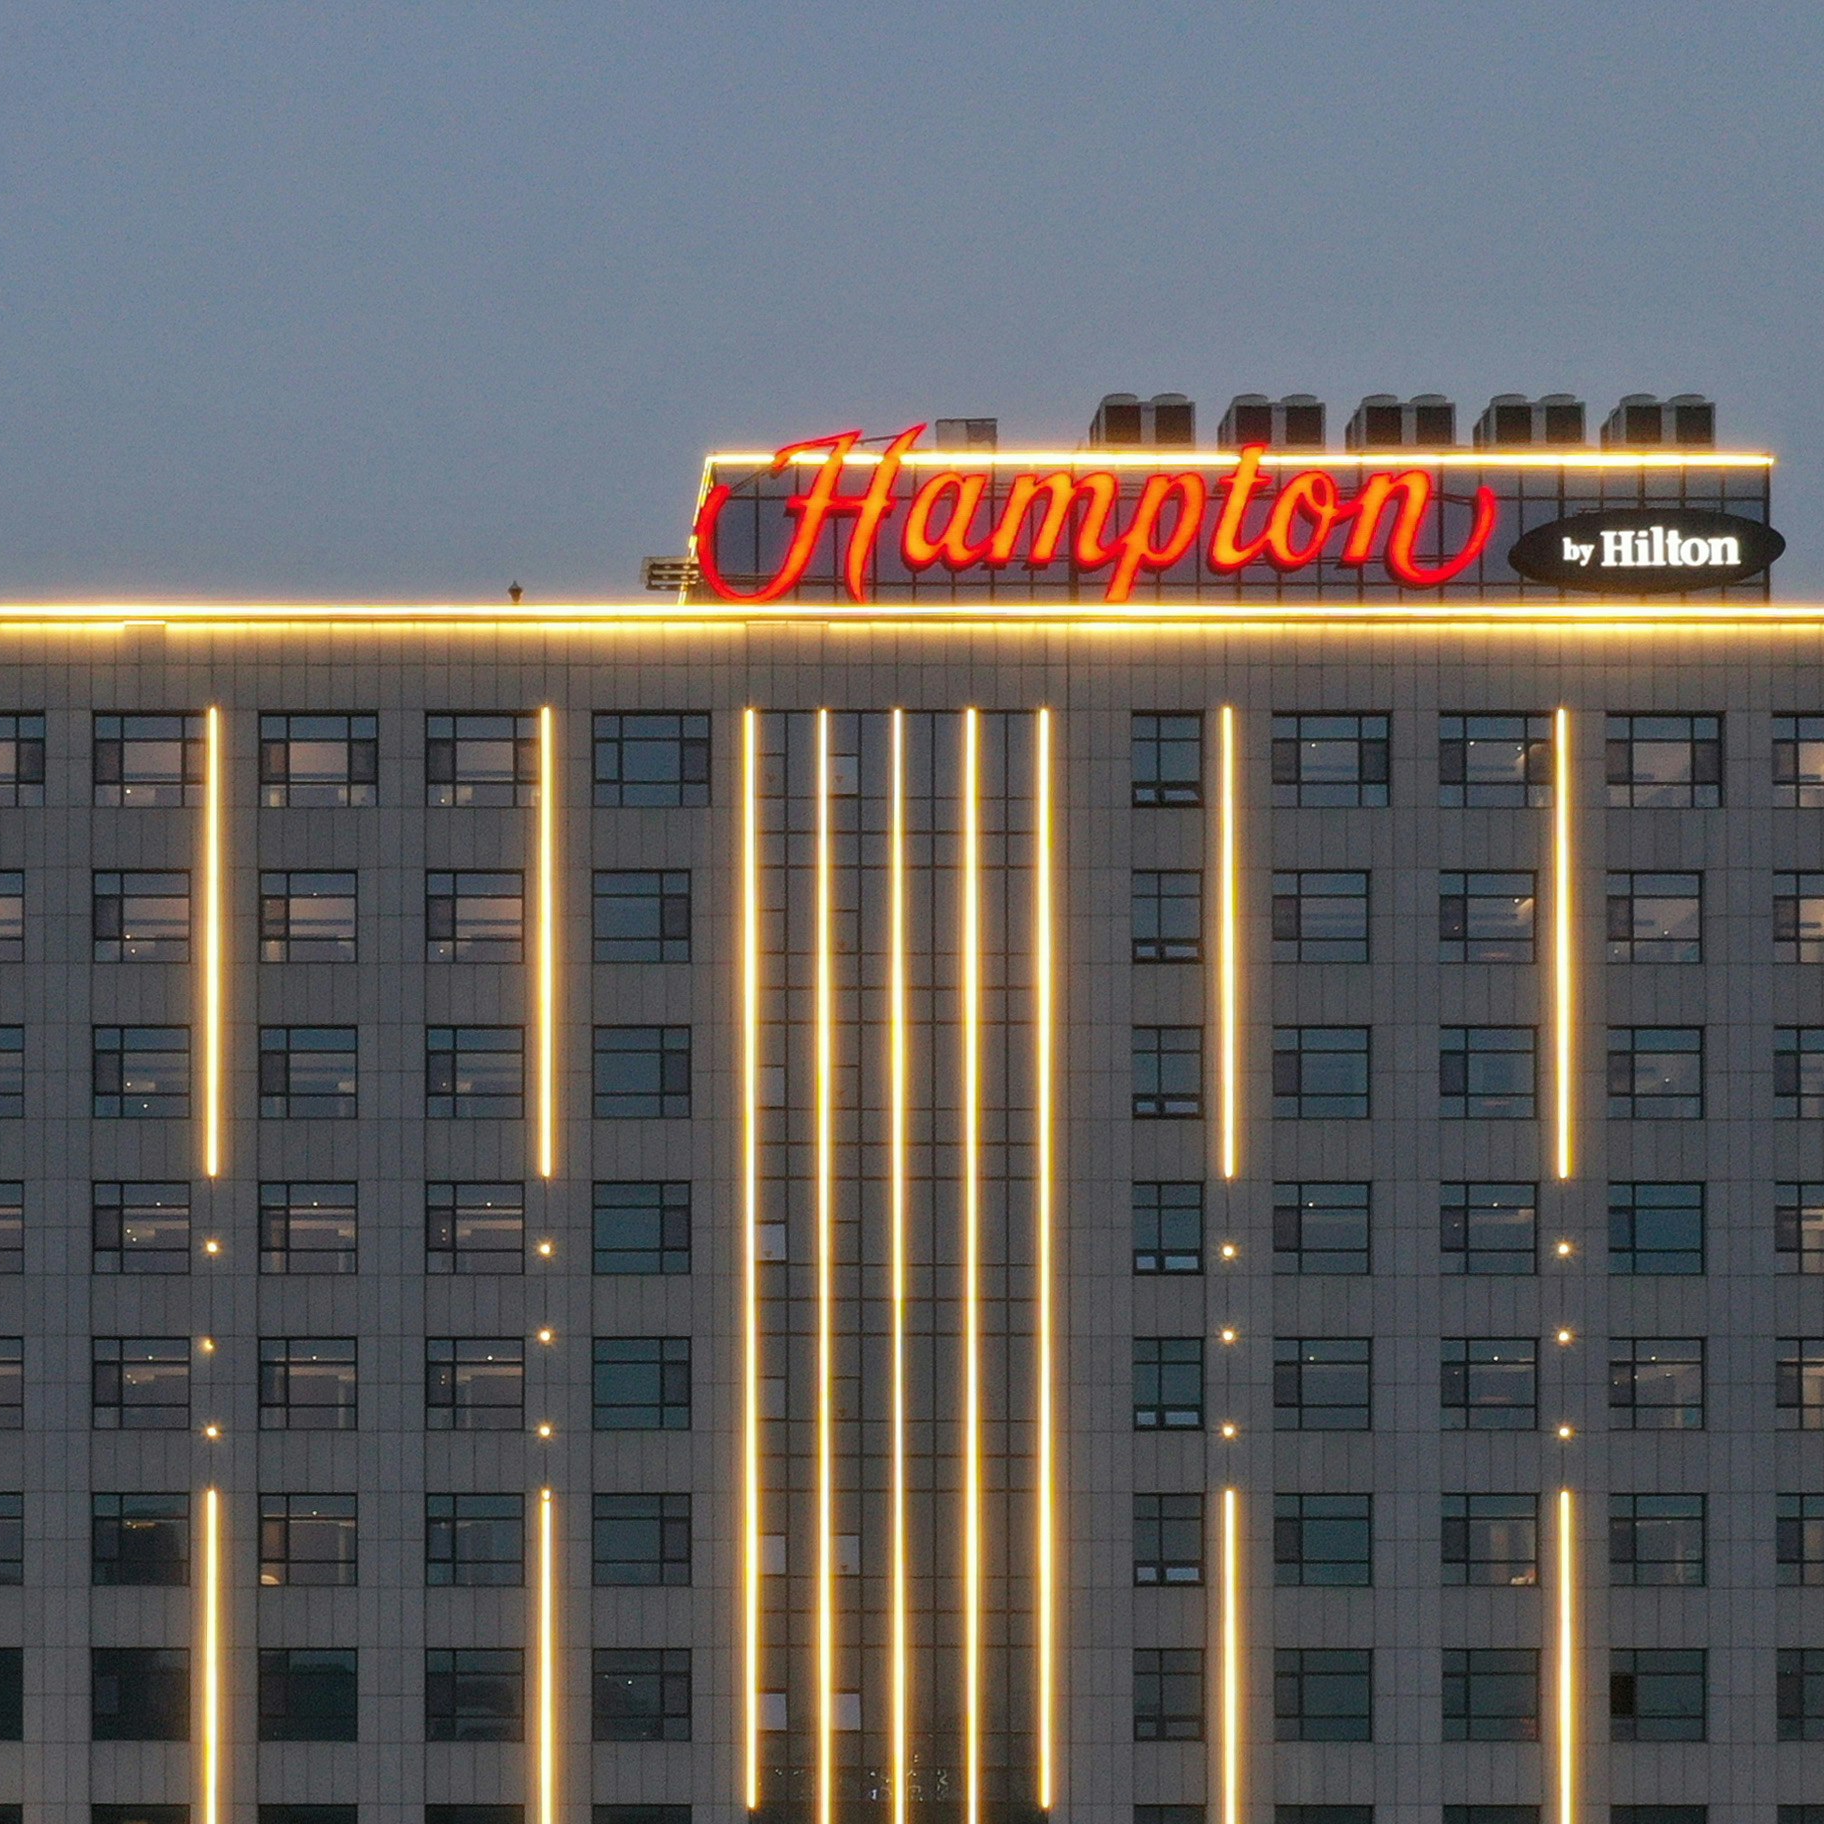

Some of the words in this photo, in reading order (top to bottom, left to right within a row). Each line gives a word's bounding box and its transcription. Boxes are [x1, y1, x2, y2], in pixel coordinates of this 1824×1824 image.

[695, 424, 1496, 604] Hampton
[1563, 537, 1594, 567] by
[1599, 526, 1741, 567] Hilton
